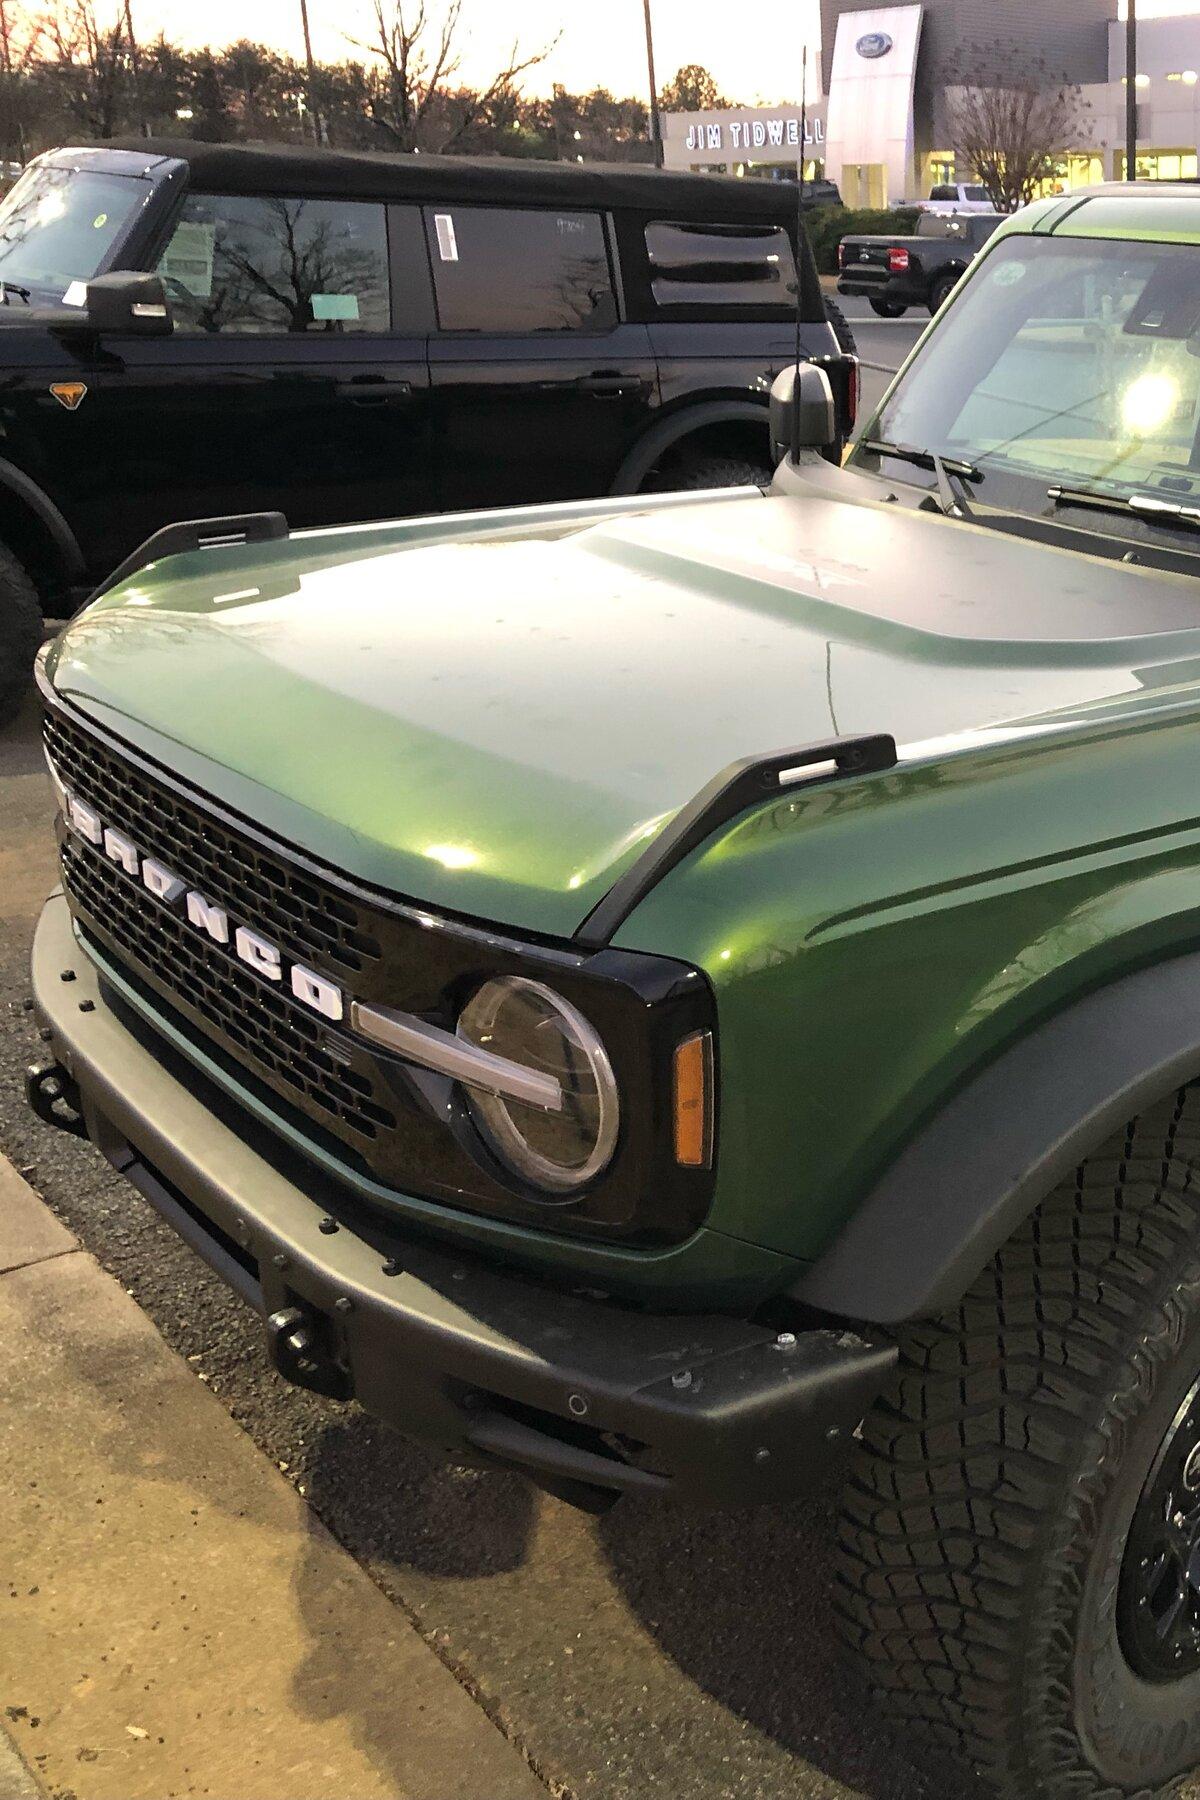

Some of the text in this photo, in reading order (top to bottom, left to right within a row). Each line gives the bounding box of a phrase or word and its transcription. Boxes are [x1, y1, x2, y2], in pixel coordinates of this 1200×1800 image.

[686, 118, 824, 150] JIM TIDWELL
[71, 795, 344, 1021] BRONCO
